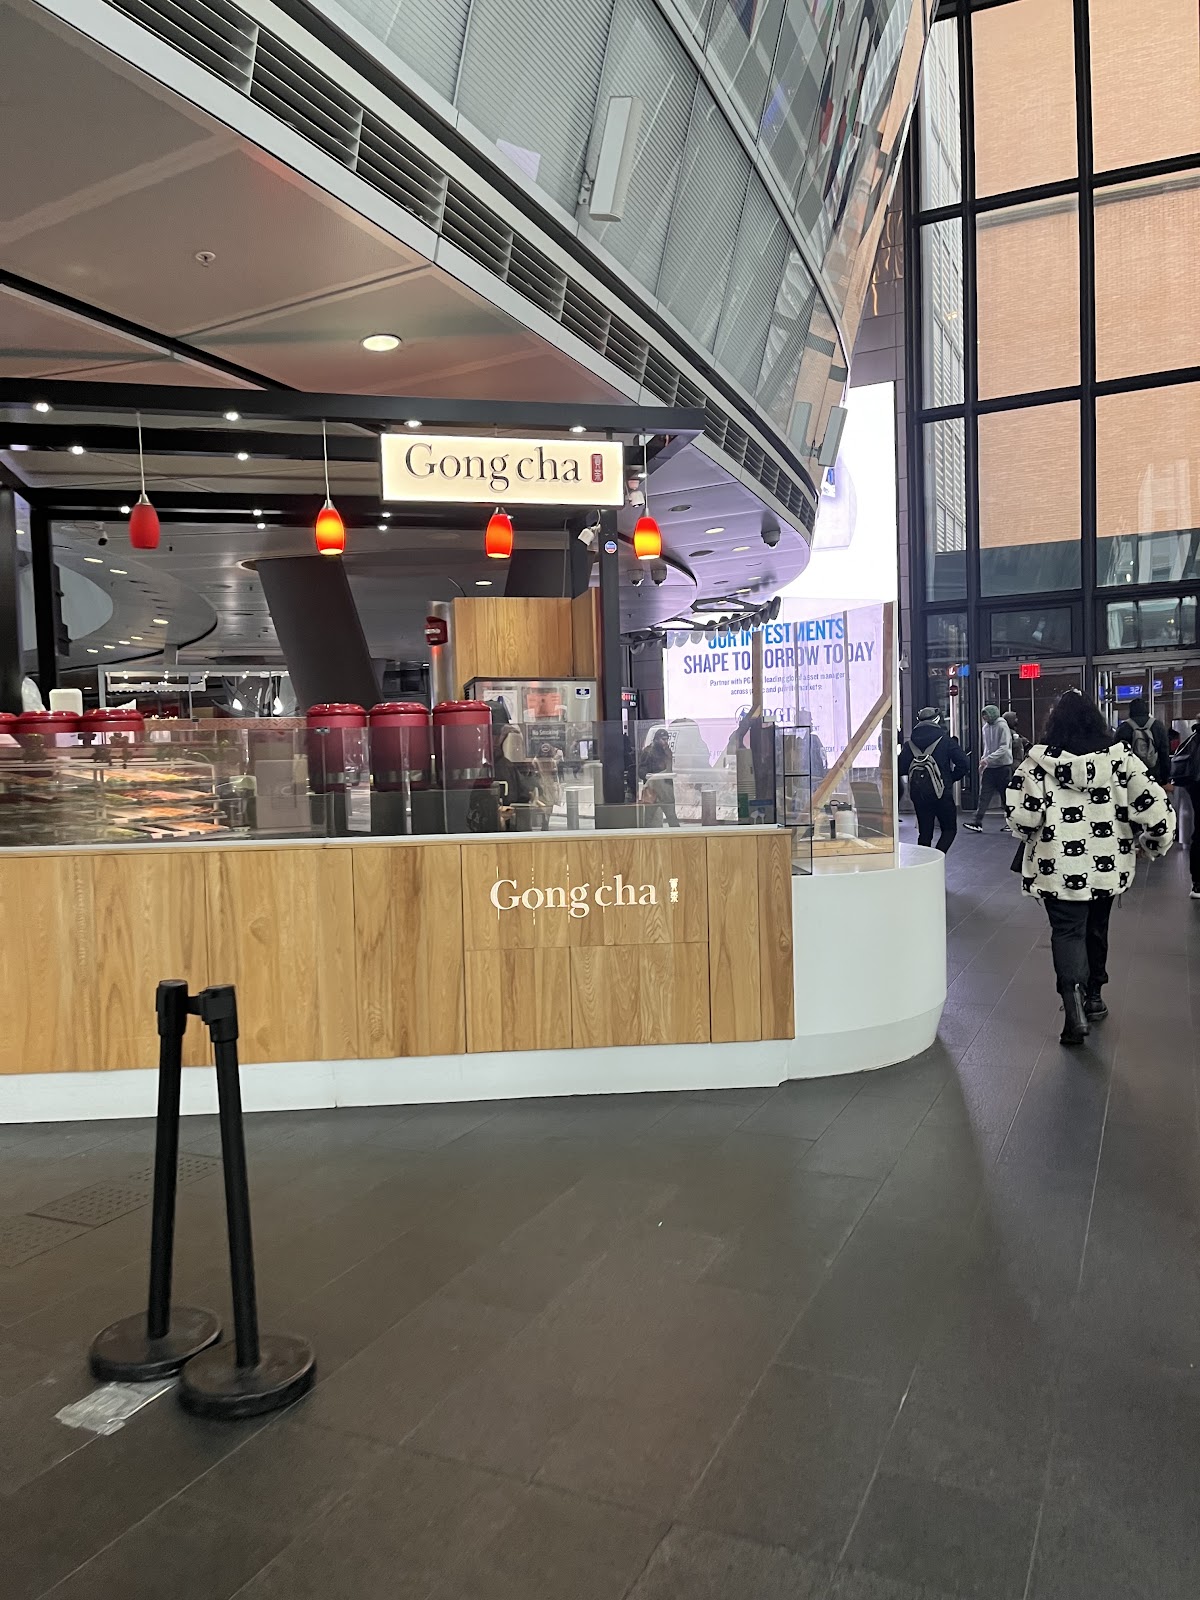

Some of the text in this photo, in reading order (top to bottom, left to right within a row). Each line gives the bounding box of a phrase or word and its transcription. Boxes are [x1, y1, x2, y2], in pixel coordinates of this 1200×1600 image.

[405, 443, 582, 493] Gong cha
[741, 618, 844, 647] INESTMENTS
[684, 641, 875, 675] SHAPE TOORROW TODAY
[710, 679, 730, 687] Partner
[731, 677, 743, 686] with
[490, 874, 658, 919] Gong cha
